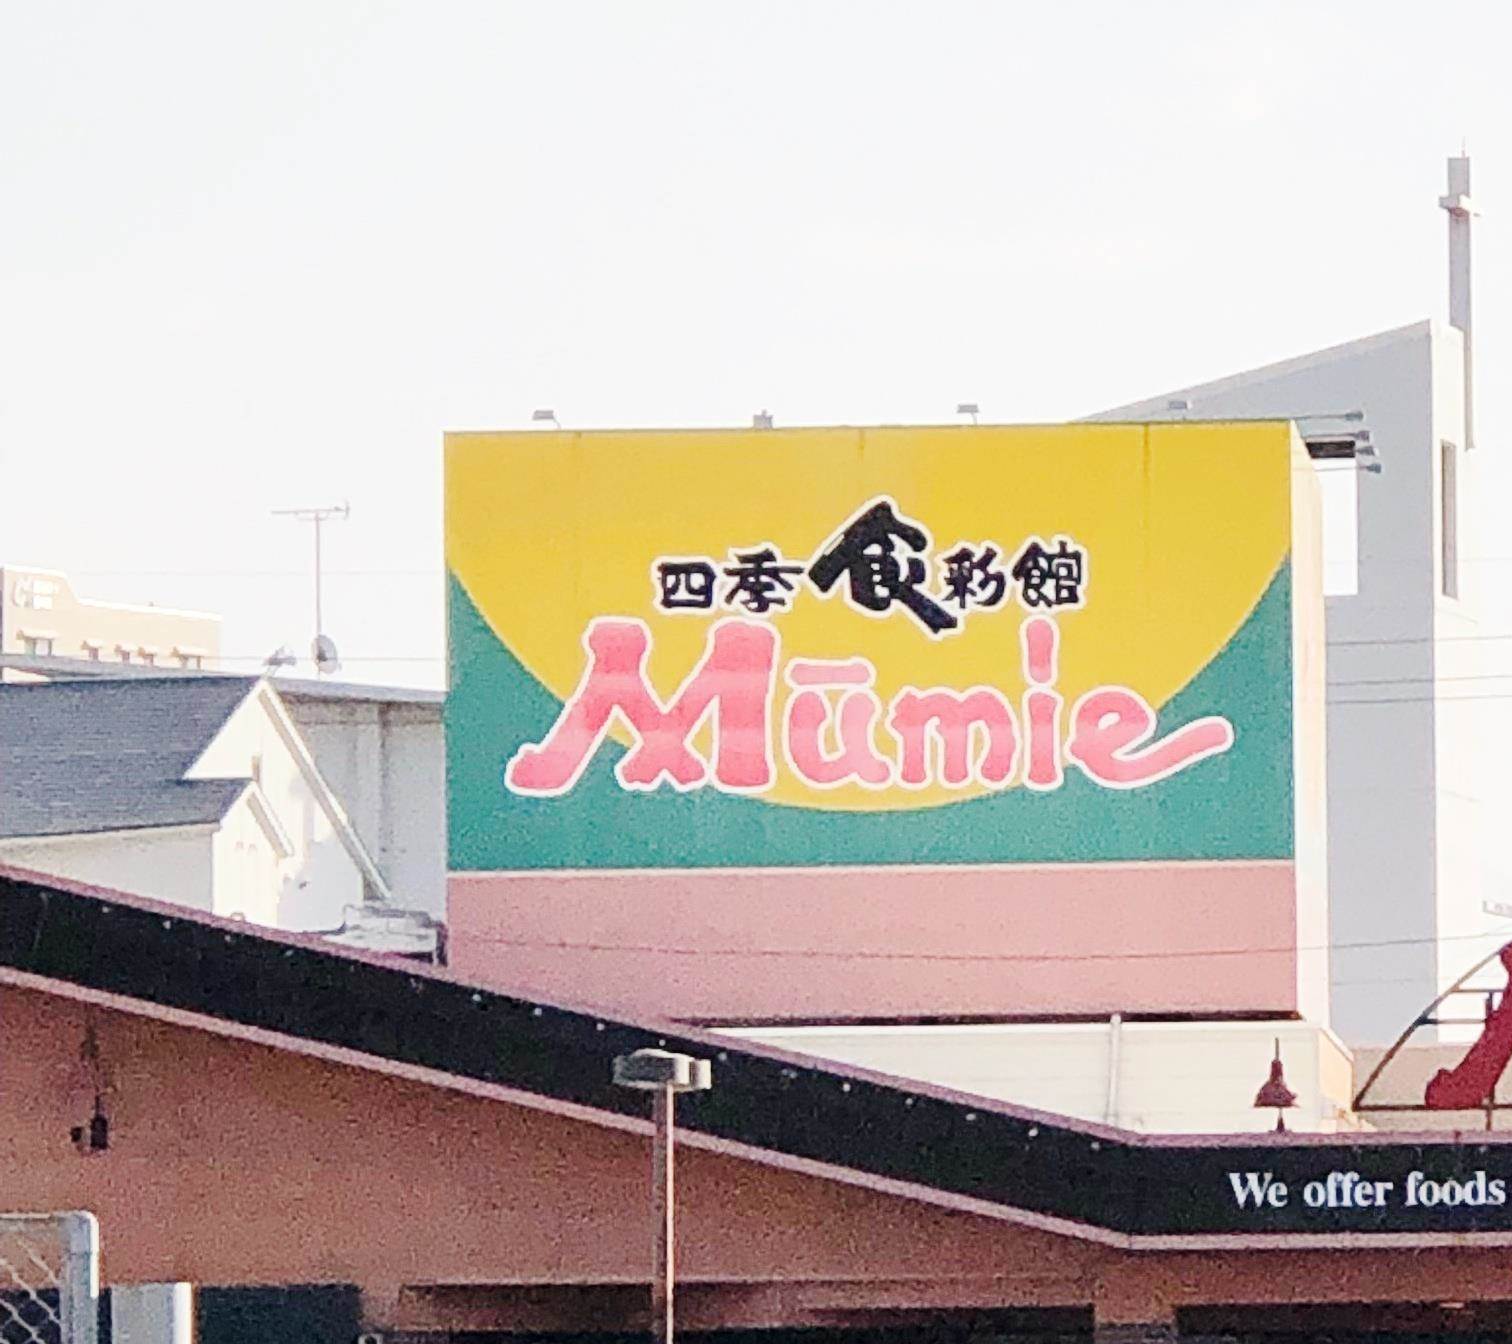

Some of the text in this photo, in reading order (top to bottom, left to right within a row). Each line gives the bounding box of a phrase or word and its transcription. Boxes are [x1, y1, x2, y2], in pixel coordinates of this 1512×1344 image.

[658, 500, 1083, 633] 四季食彩館
[1229, 1172, 1288, 1208] We
[1303, 1171, 1394, 1207] offer
[1404, 1170, 1506, 1206] foods
